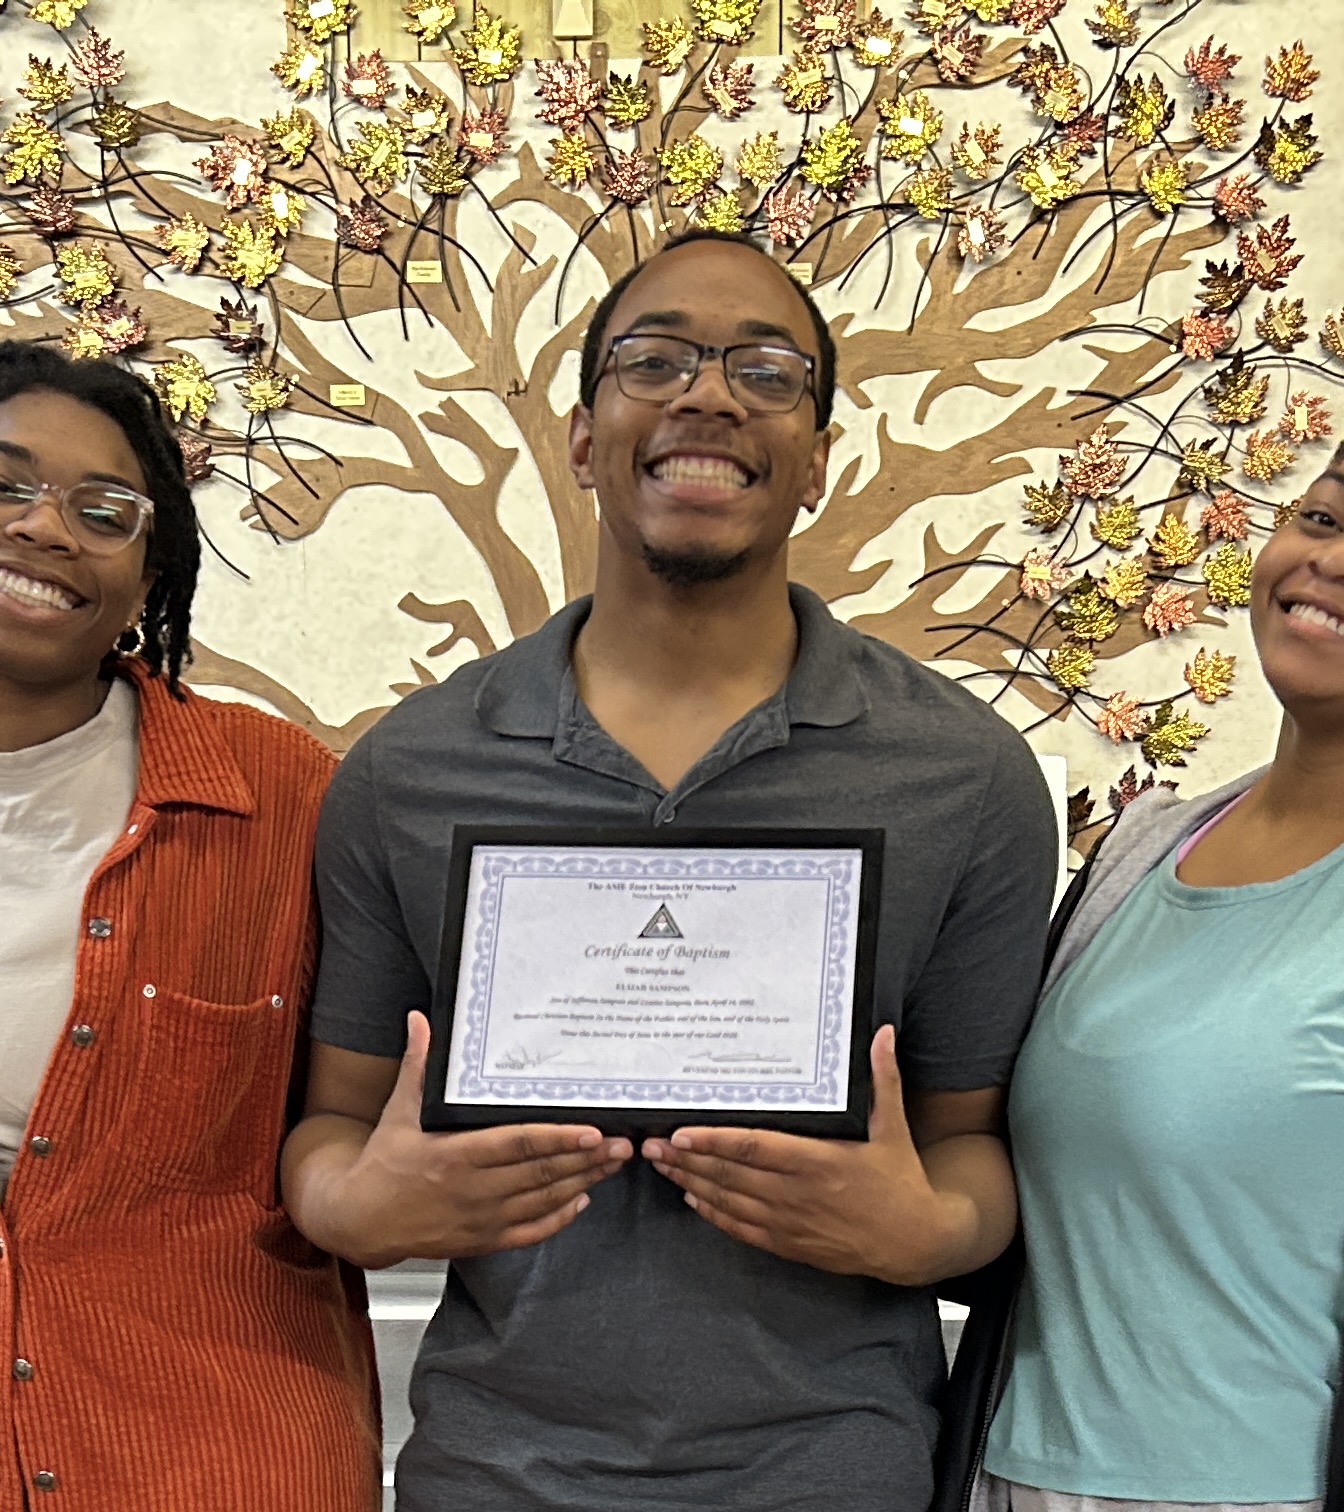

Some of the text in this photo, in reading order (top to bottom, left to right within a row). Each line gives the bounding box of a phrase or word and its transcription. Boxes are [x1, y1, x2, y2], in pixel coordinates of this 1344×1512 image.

[584, 942, 731, 962] Certificate of Baptism
